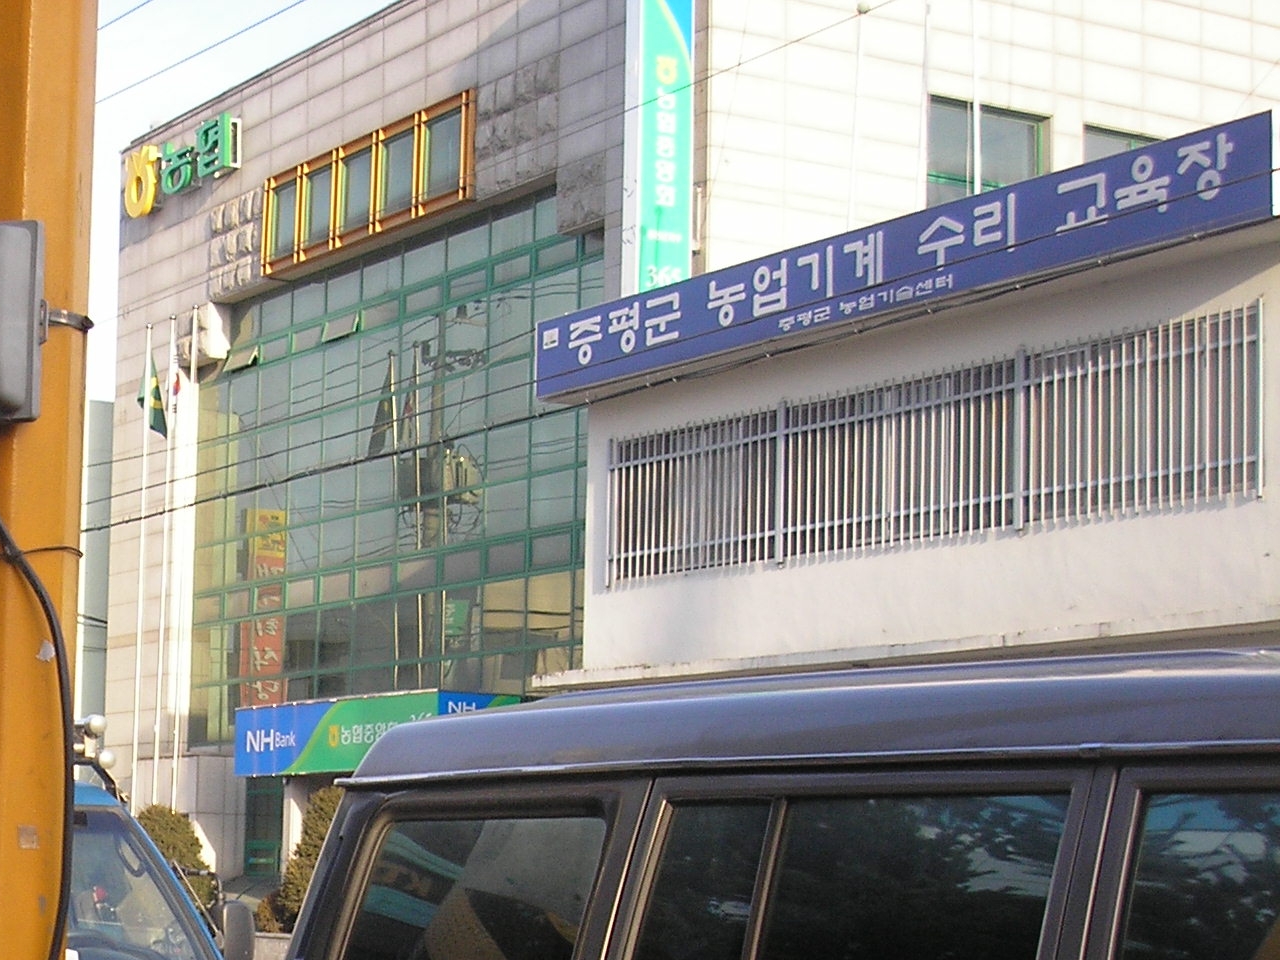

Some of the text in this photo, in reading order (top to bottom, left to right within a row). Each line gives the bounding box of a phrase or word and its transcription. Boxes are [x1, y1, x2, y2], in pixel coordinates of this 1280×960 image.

[161, 112, 241, 195] 농협
[568, 131, 1234, 365] 증평군 농업기계 수리 교육장
